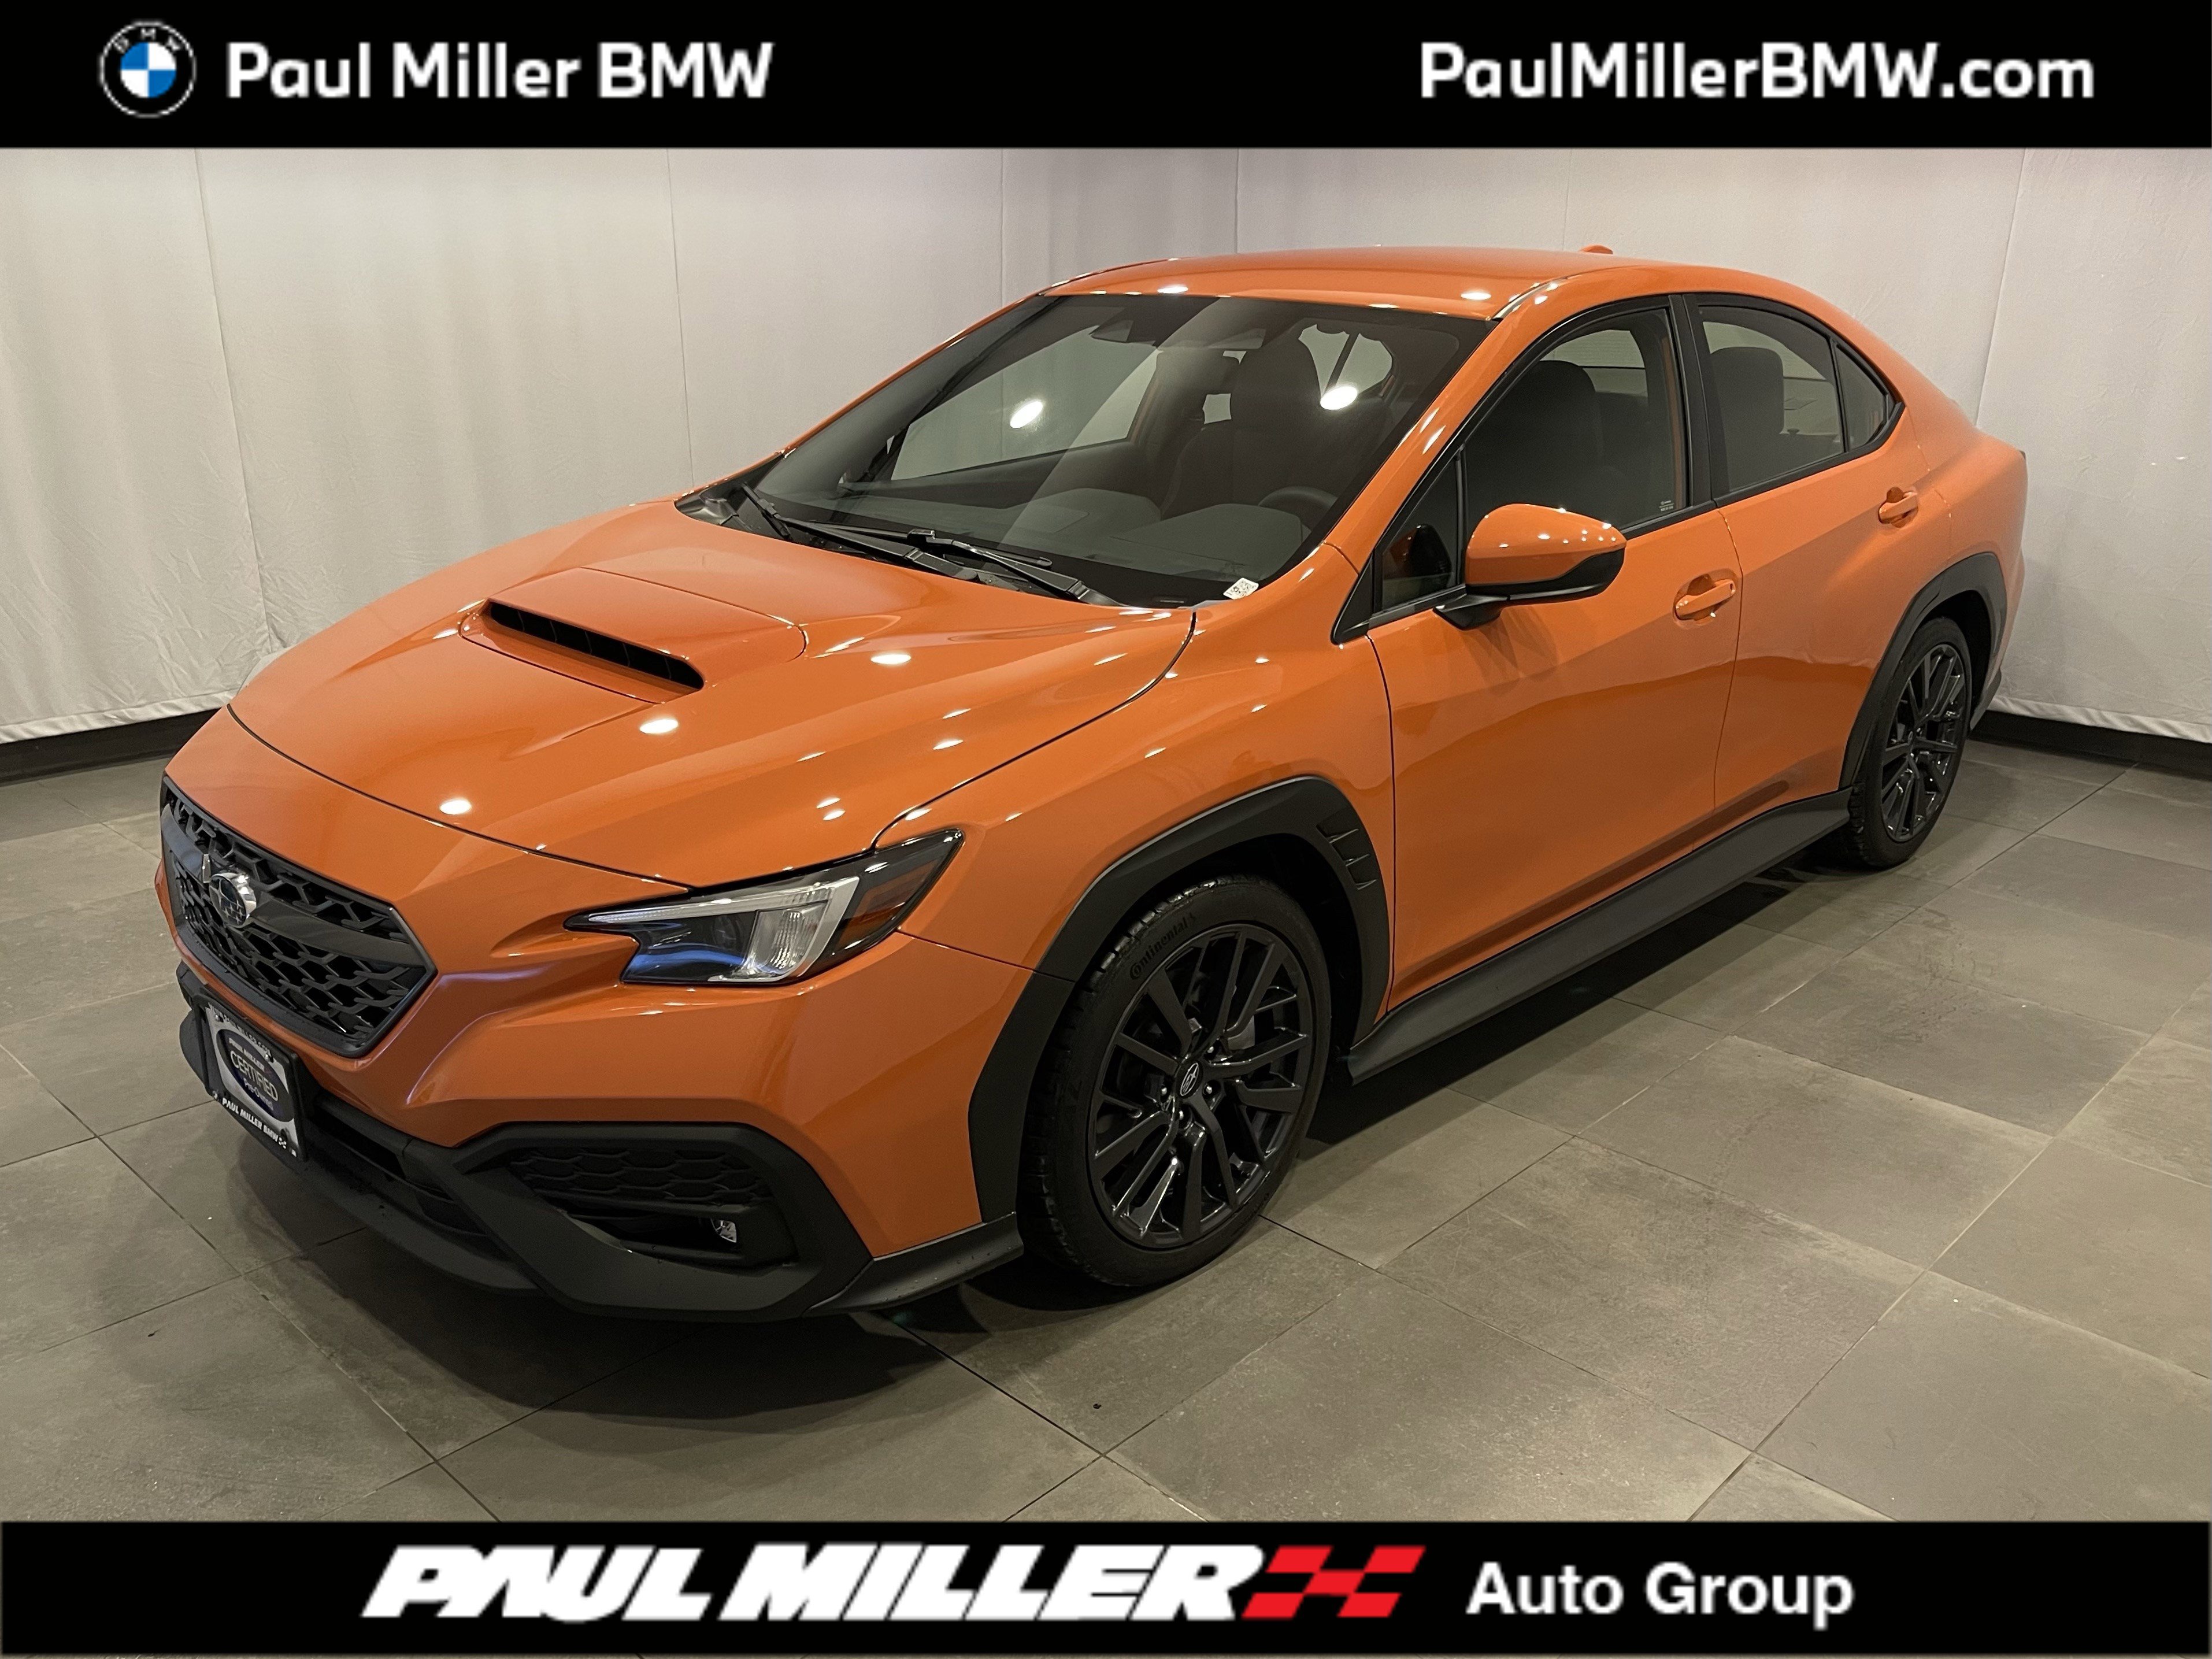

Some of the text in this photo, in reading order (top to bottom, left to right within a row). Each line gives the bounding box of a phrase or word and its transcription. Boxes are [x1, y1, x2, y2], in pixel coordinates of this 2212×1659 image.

[1129, 916, 1188, 980] Continental
[231, 1051, 278, 1101] CERTIFIED
[222, 1098, 239, 1114] PAUL
[240, 1109, 262, 1130] MILLER
